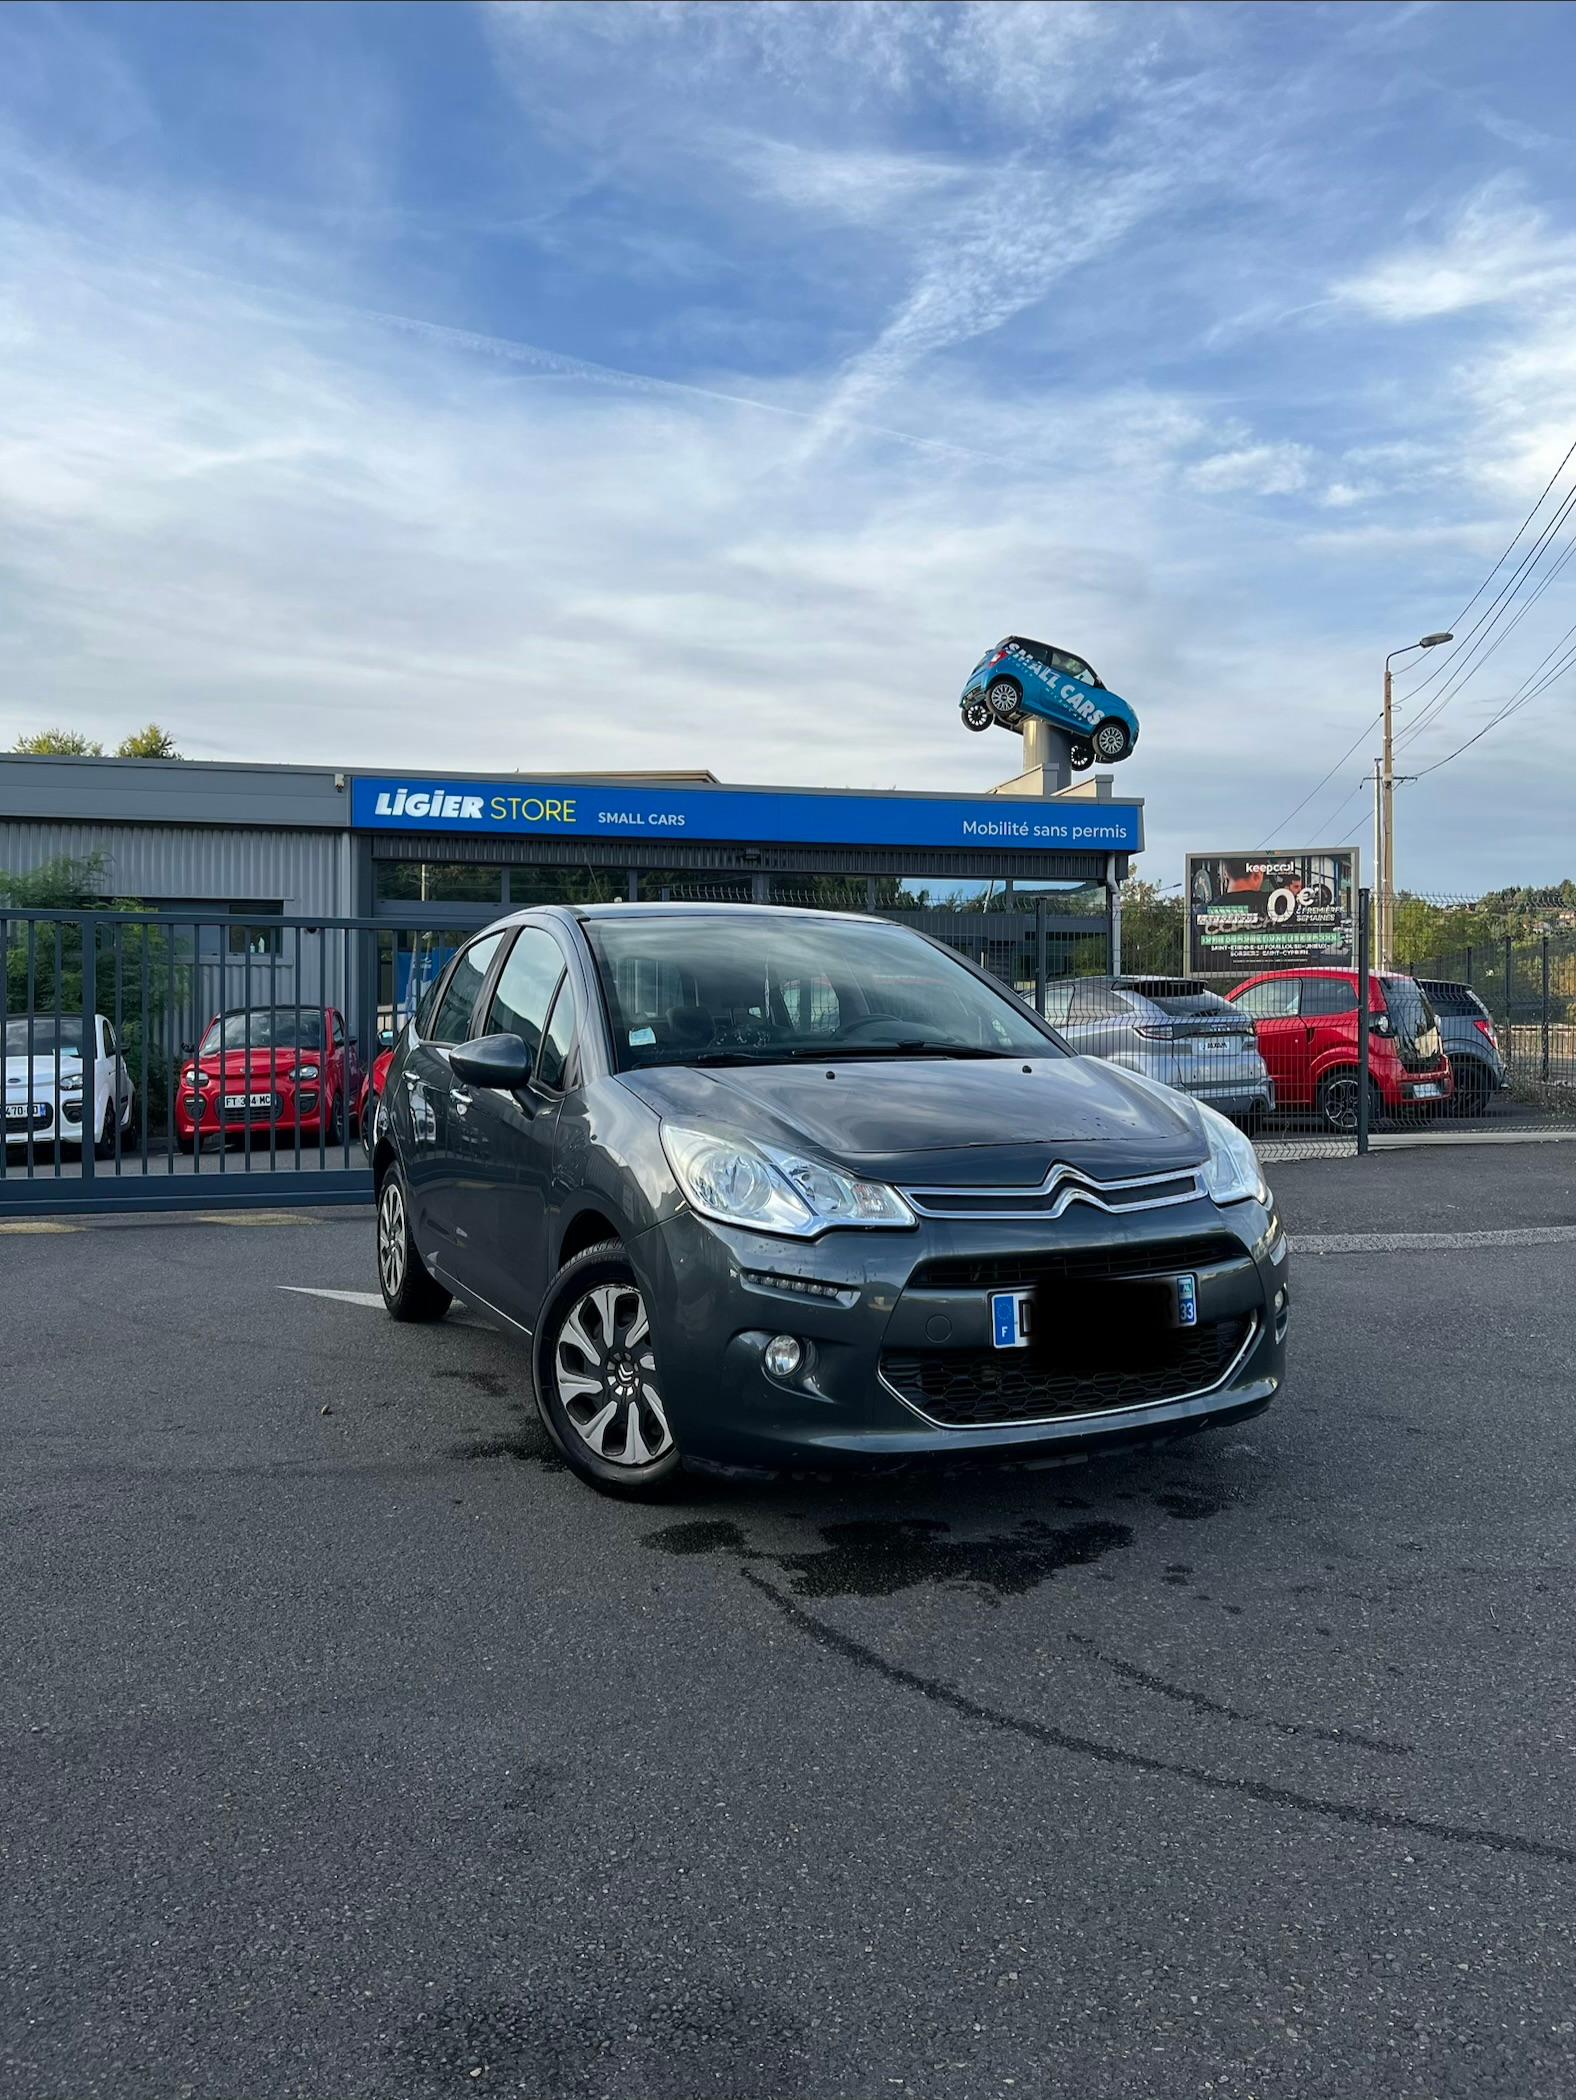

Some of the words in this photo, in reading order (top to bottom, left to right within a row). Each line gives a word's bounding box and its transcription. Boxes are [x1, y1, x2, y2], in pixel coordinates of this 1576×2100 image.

[1005, 643, 1061, 689] SMALL
[1060, 684, 1105, 725] CARS
[490, 797, 577, 823] STORE
[598, 811, 645, 825] SMALL
[648, 813, 685, 826] CARS
[963, 820, 1029, 837] Mobilité
[1033, 824, 1068, 837] sans
[1072, 823, 1127, 839] permis
[1246, 862, 1294, 875] keepcool
[1296, 914, 1335, 922] SEMAINES
[1180, 1302, 1194, 1320] 33
[1001, 1326, 1008, 1338] F
